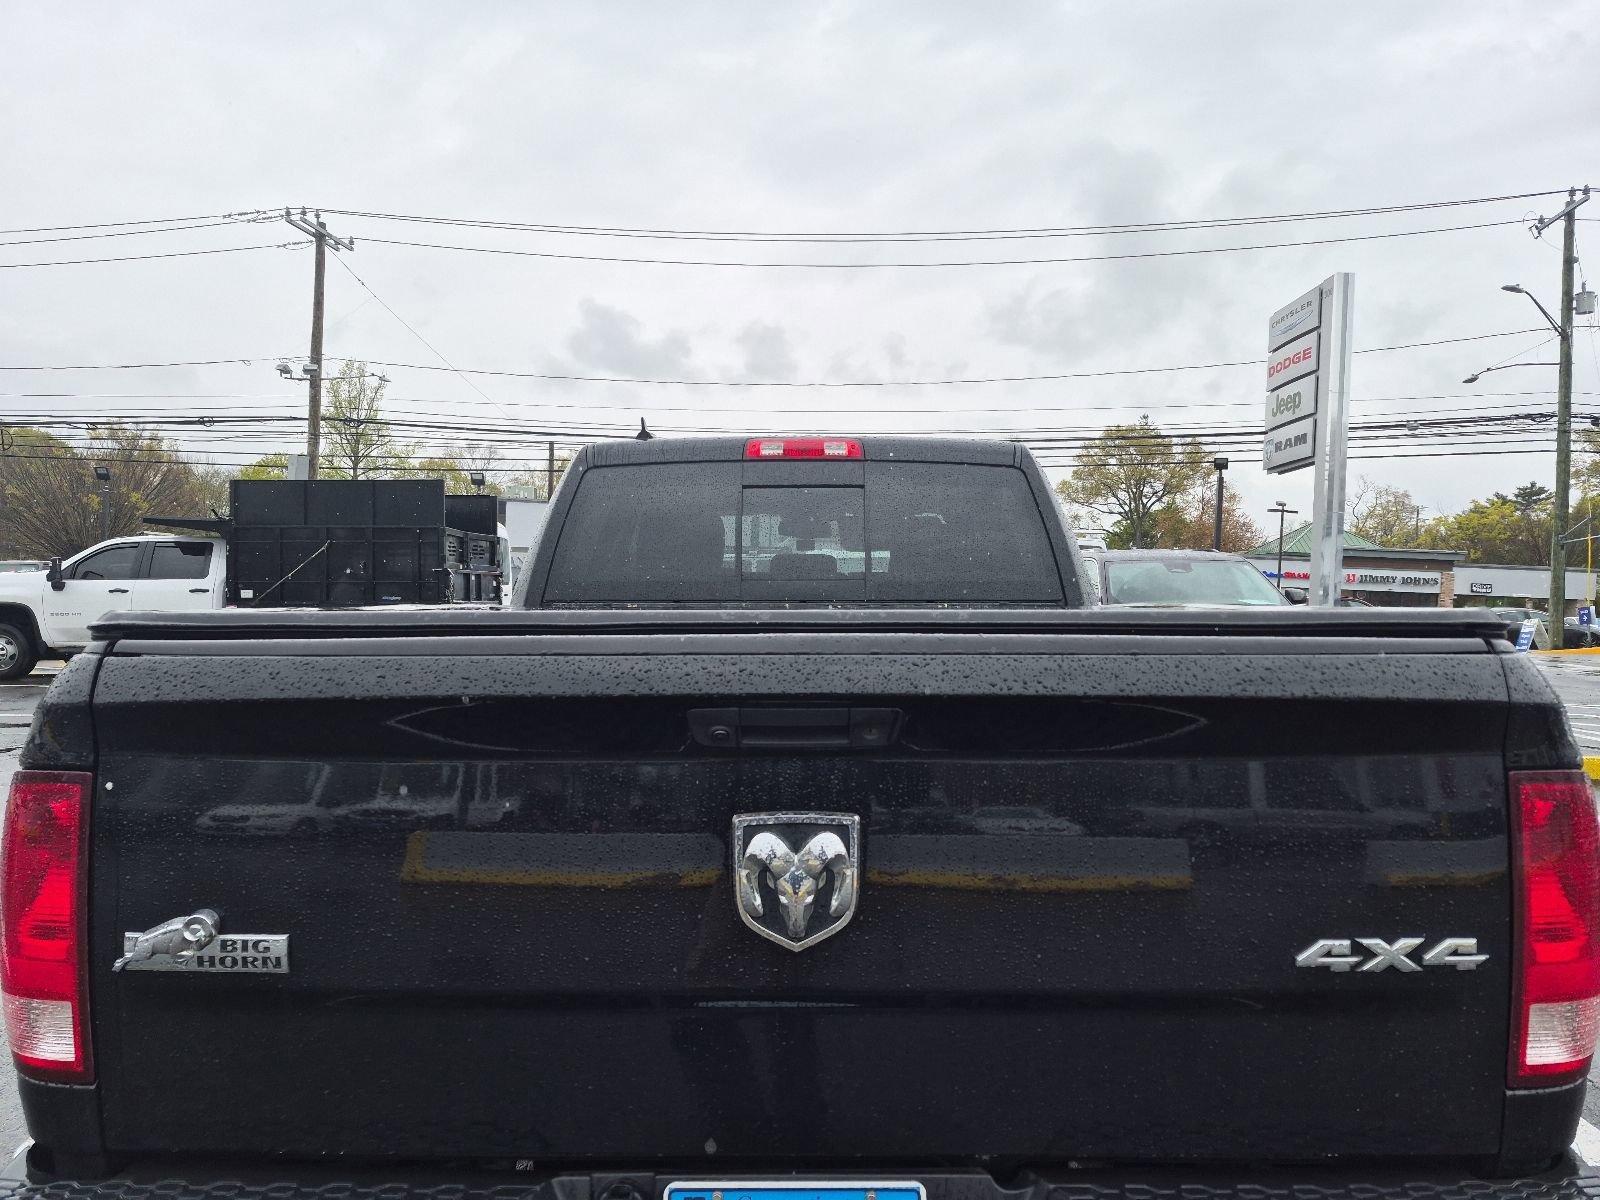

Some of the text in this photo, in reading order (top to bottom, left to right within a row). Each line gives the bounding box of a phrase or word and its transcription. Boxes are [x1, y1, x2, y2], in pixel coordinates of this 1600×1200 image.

[1271, 300, 1313, 329] CHRYSLER
[1268, 346, 1313, 378] DODGE
[1271, 390, 1302, 418] Jeep
[1274, 432, 1308, 453] RAM
[1359, 574, 1439, 586] JIMMY JOHN'S
[219, 938, 271, 954] BIG
[196, 955, 282, 969] HORN
